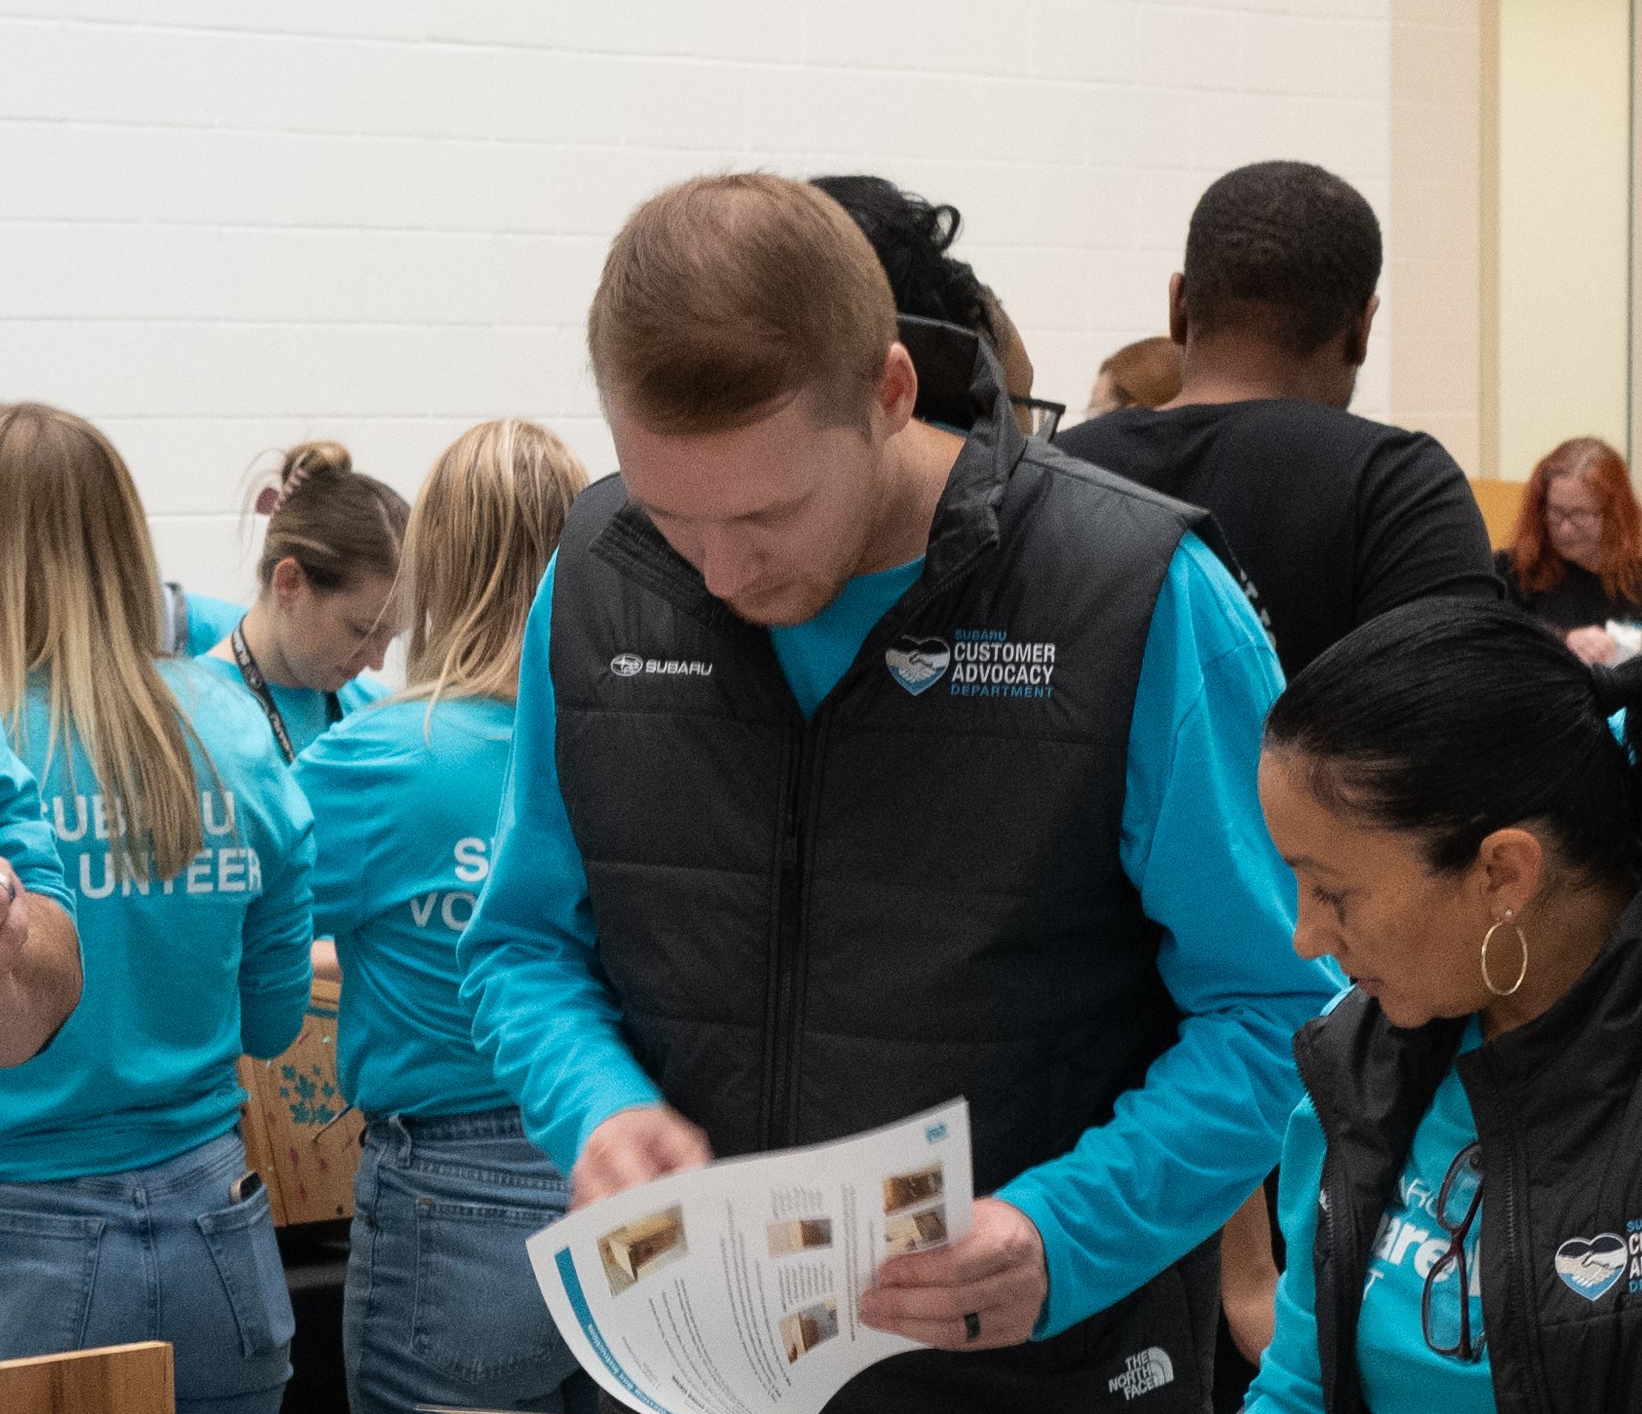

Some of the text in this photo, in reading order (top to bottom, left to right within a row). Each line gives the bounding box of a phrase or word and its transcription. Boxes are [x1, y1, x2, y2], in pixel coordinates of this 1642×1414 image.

[955, 629, 1007, 642] SUBARU
[954, 642, 1056, 664] CUSTOMER
[645, 659, 713, 677] SUBARU
[952, 664, 1054, 686] ADVOCACY
[950, 685, 1054, 699] DEPARTMENT
[1125, 1349, 1149, 1371] THE
[1109, 1362, 1152, 1393] NORTH
[1124, 1376, 1154, 1401] FACE
